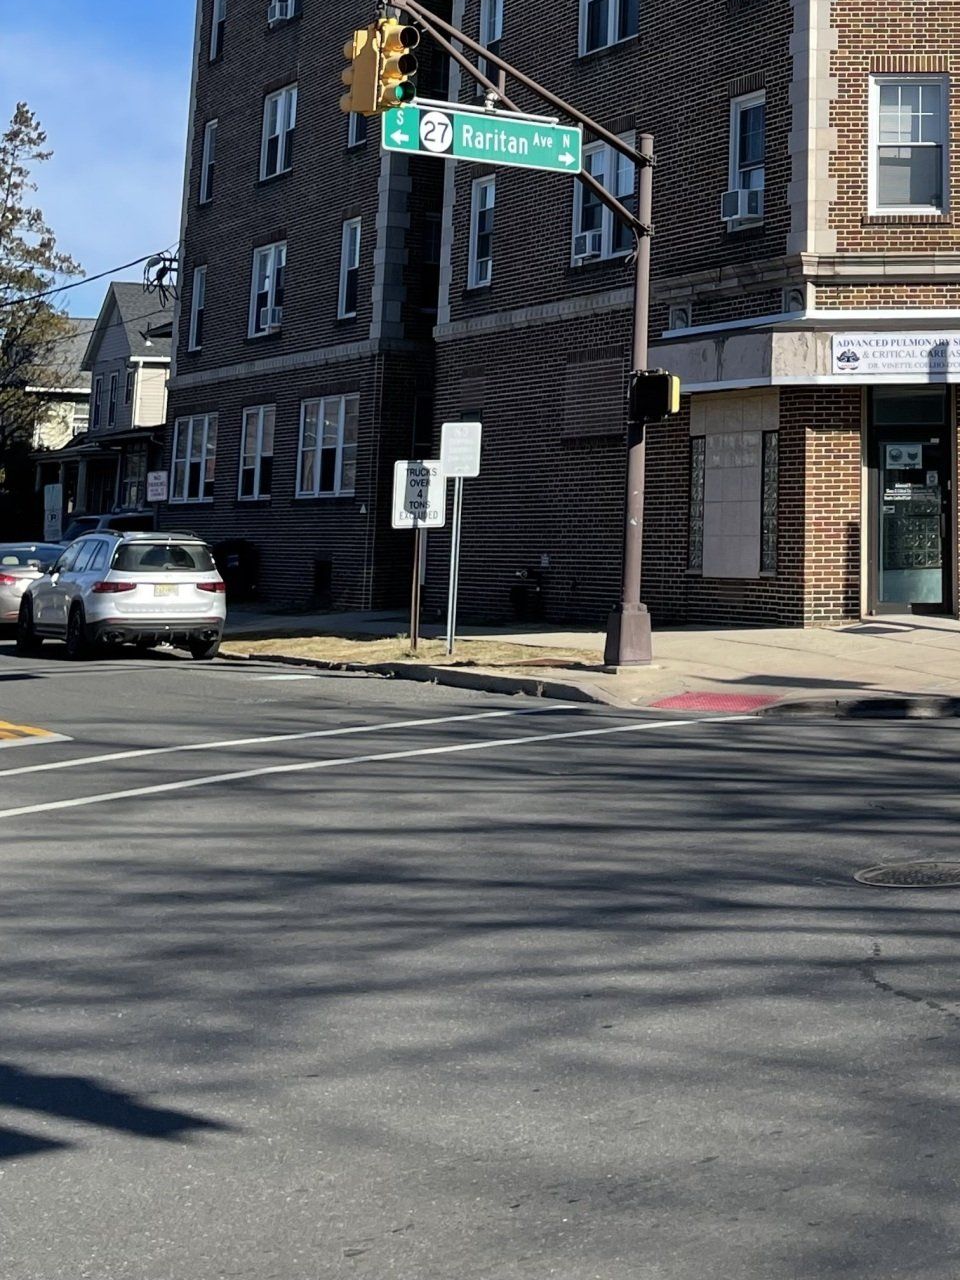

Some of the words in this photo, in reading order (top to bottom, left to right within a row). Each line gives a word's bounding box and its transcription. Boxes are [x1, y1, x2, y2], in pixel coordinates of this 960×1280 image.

[396, 109, 405, 126] S
[424, 120, 449, 144] 27
[462, 124, 529, 155] Raritan
[533, 132, 553, 149] Ave
[562, 133, 570, 148] N
[837, 339, 889, 348] ADVANCED
[890, 338, 950, 347] PULMONARY
[862, 350, 869, 359] &
[872, 350, 917, 359] CRITICAL
[920, 349, 945, 358] CARE
[405, 468, 437, 477] TRUCKS
[410, 479, 431, 487] OVER
[417, 489, 423, 499] 4
[409, 500, 431, 509] TONS
[399, 510, 438, 520] EXCLUDED
